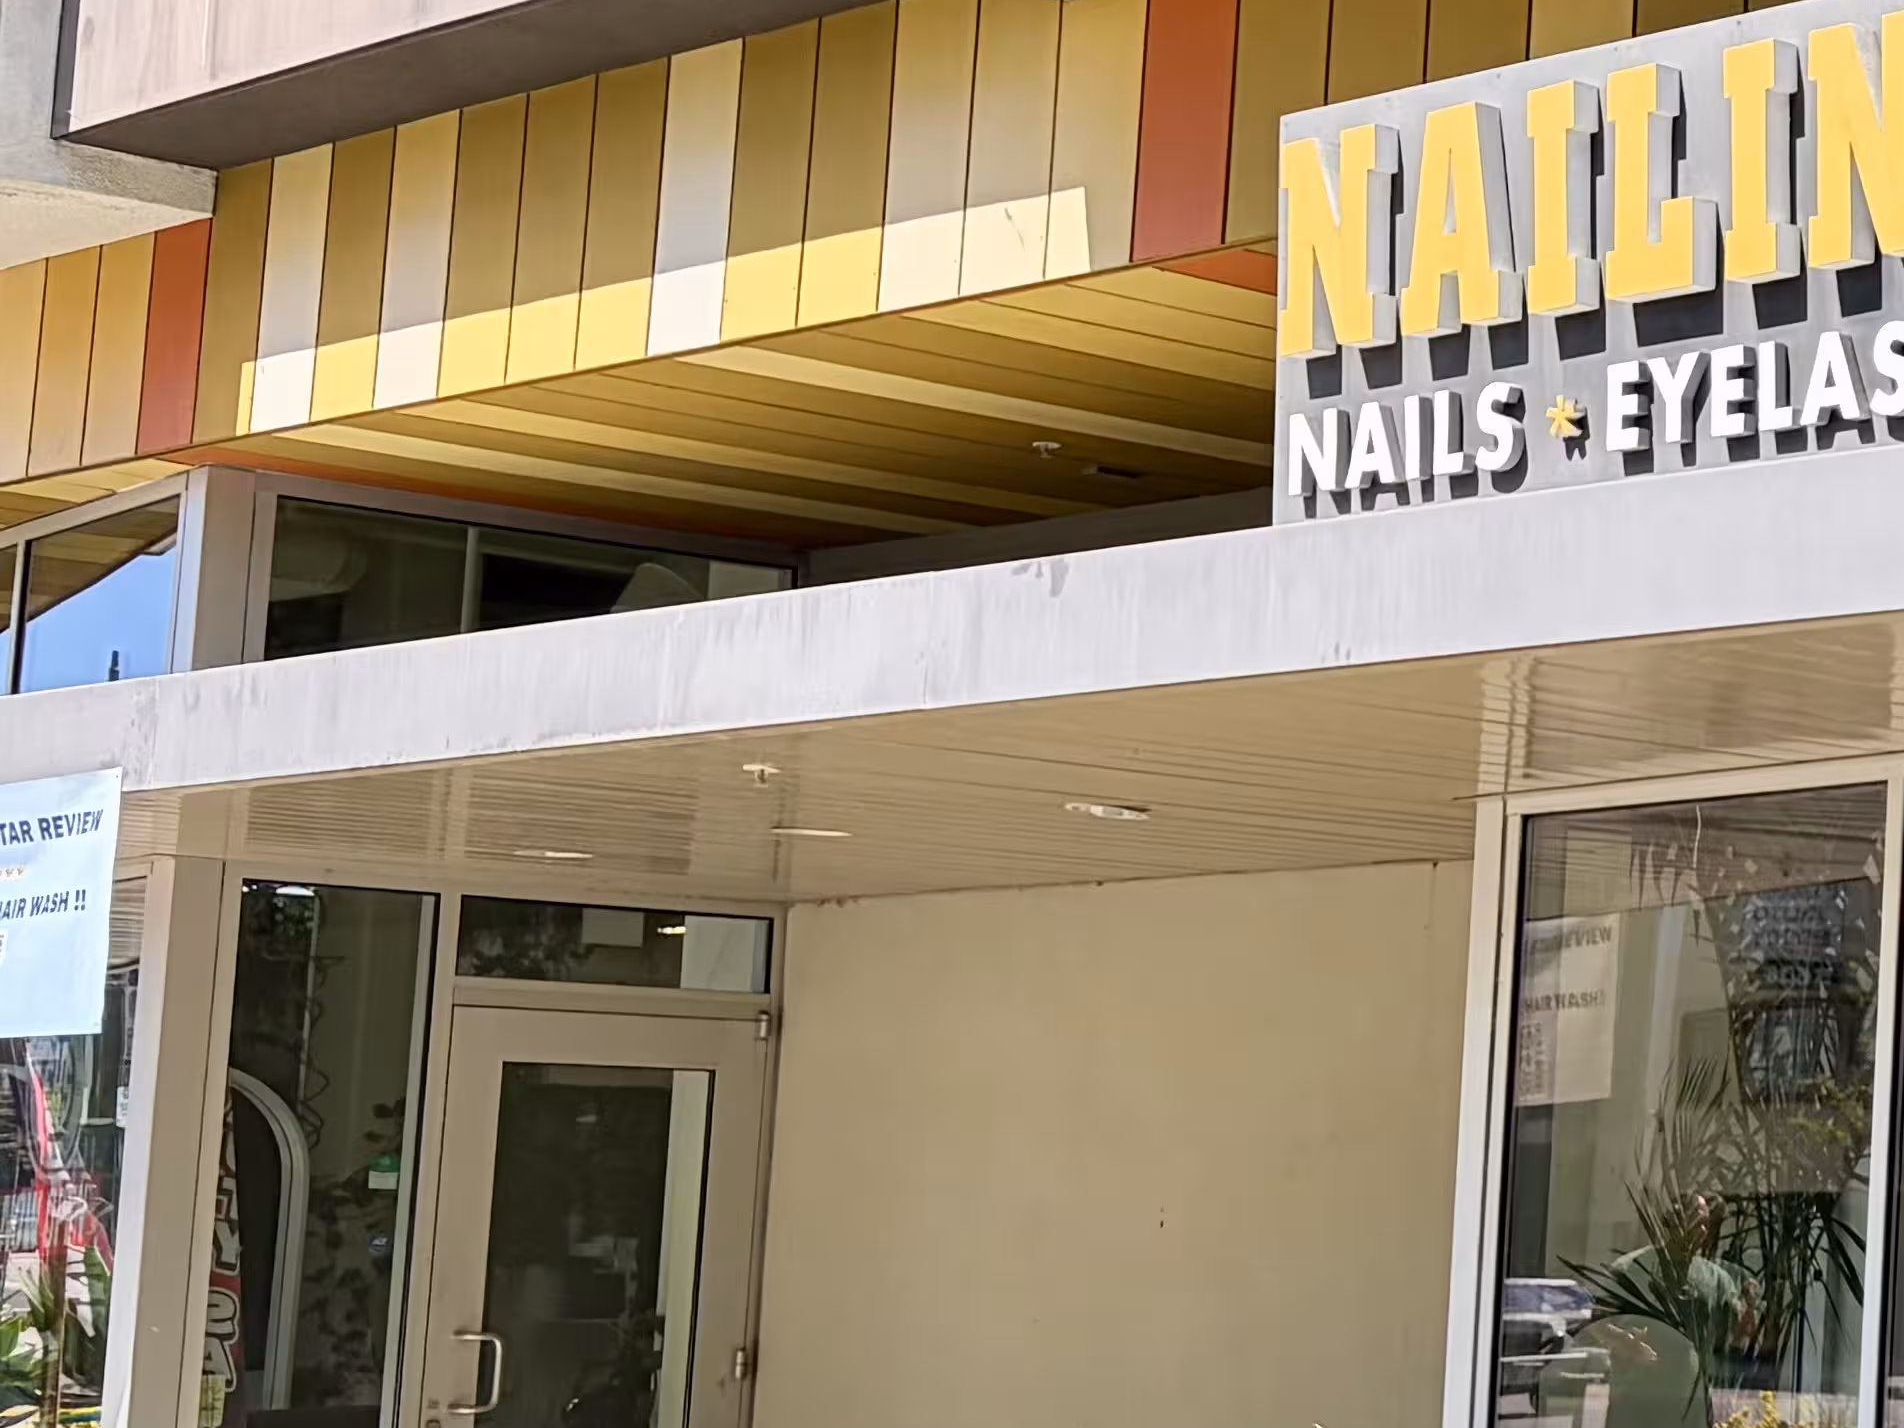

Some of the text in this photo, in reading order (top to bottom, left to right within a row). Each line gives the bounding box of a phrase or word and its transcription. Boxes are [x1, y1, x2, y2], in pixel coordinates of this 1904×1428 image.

[1286, 381, 1523, 497] NAILS
[37, 808, 104, 841] REVIEW
[30, 890, 69, 917] WASH
[74, 889, 87, 911] !!
